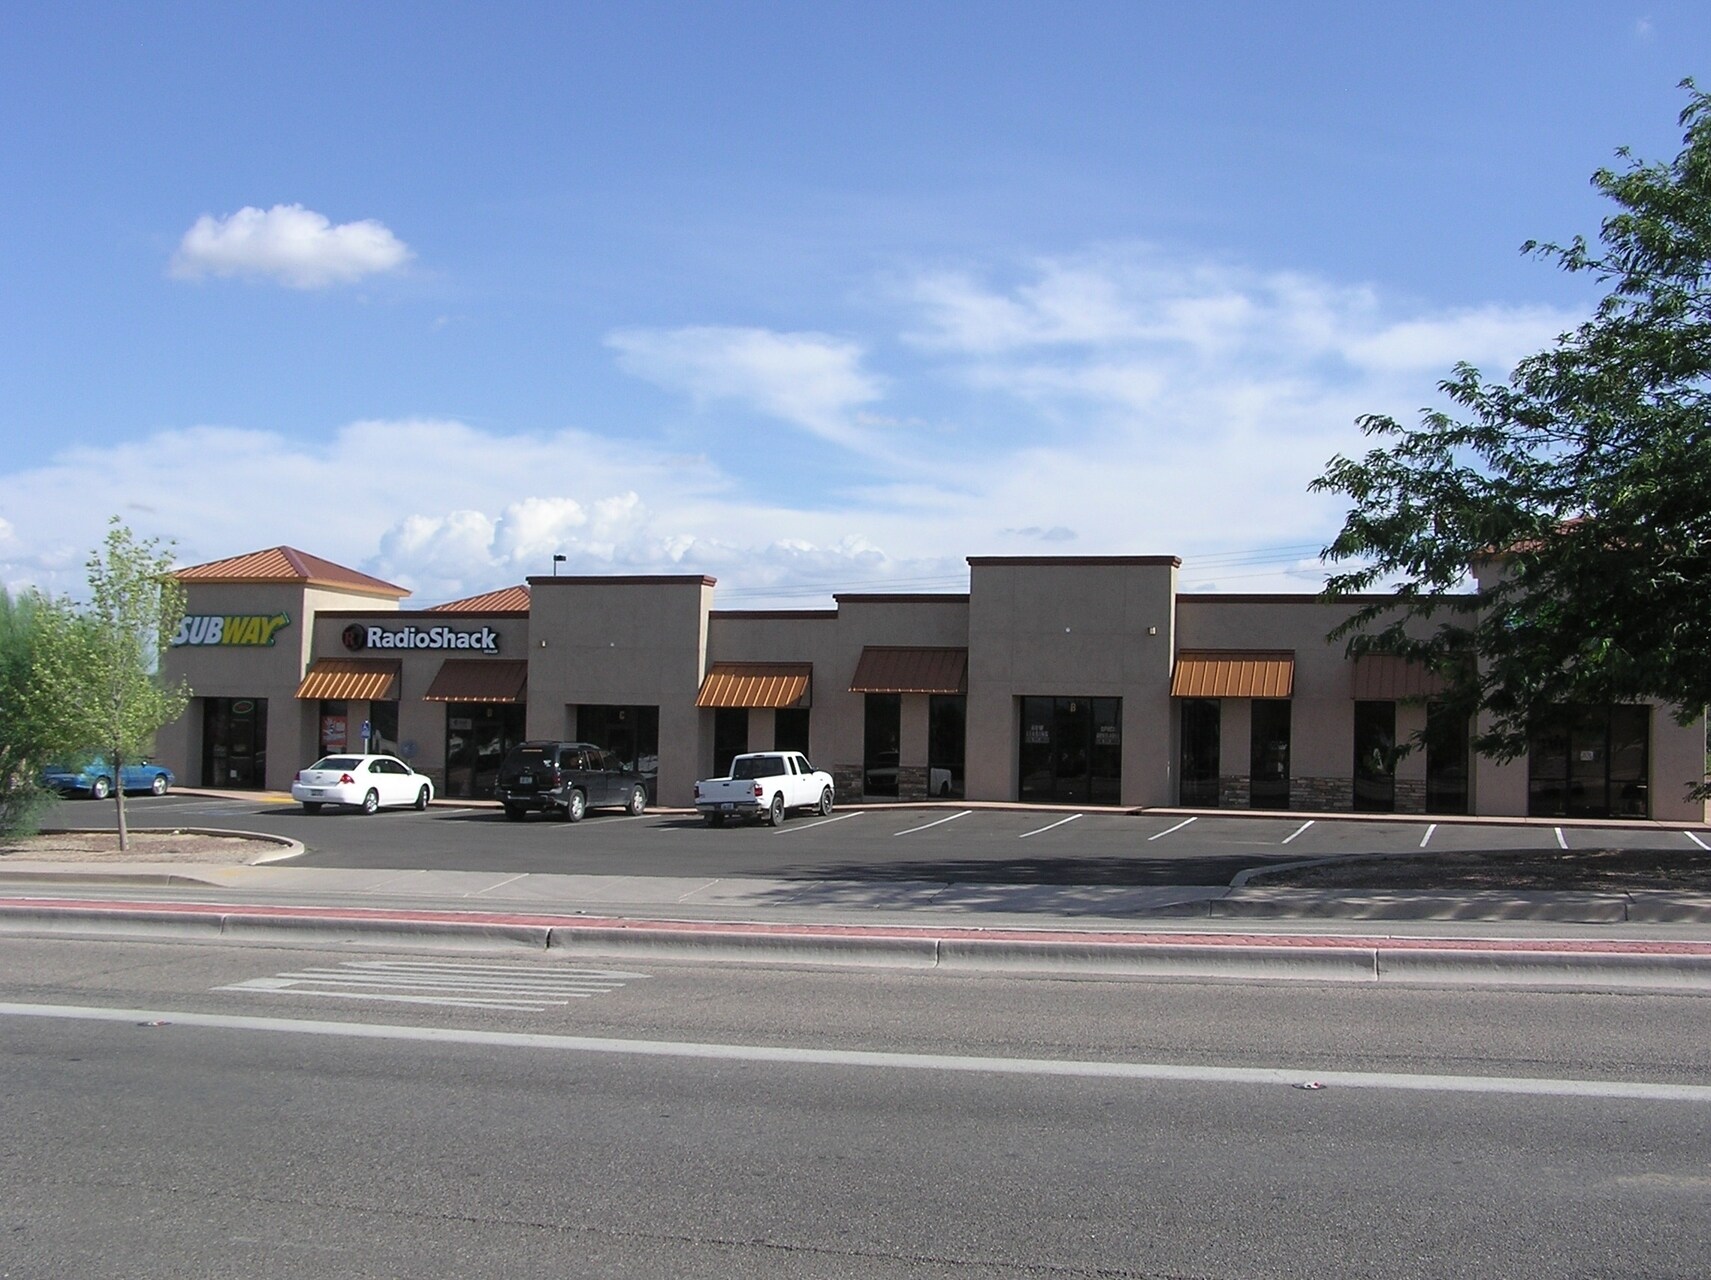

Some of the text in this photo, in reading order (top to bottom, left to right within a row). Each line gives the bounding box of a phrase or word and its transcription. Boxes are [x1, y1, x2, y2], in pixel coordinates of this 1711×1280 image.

[172, 613, 289, 645] SUBWAY
[366, 626, 497, 649] RadioShack
[209, 961, 653, 1012] ONLY
